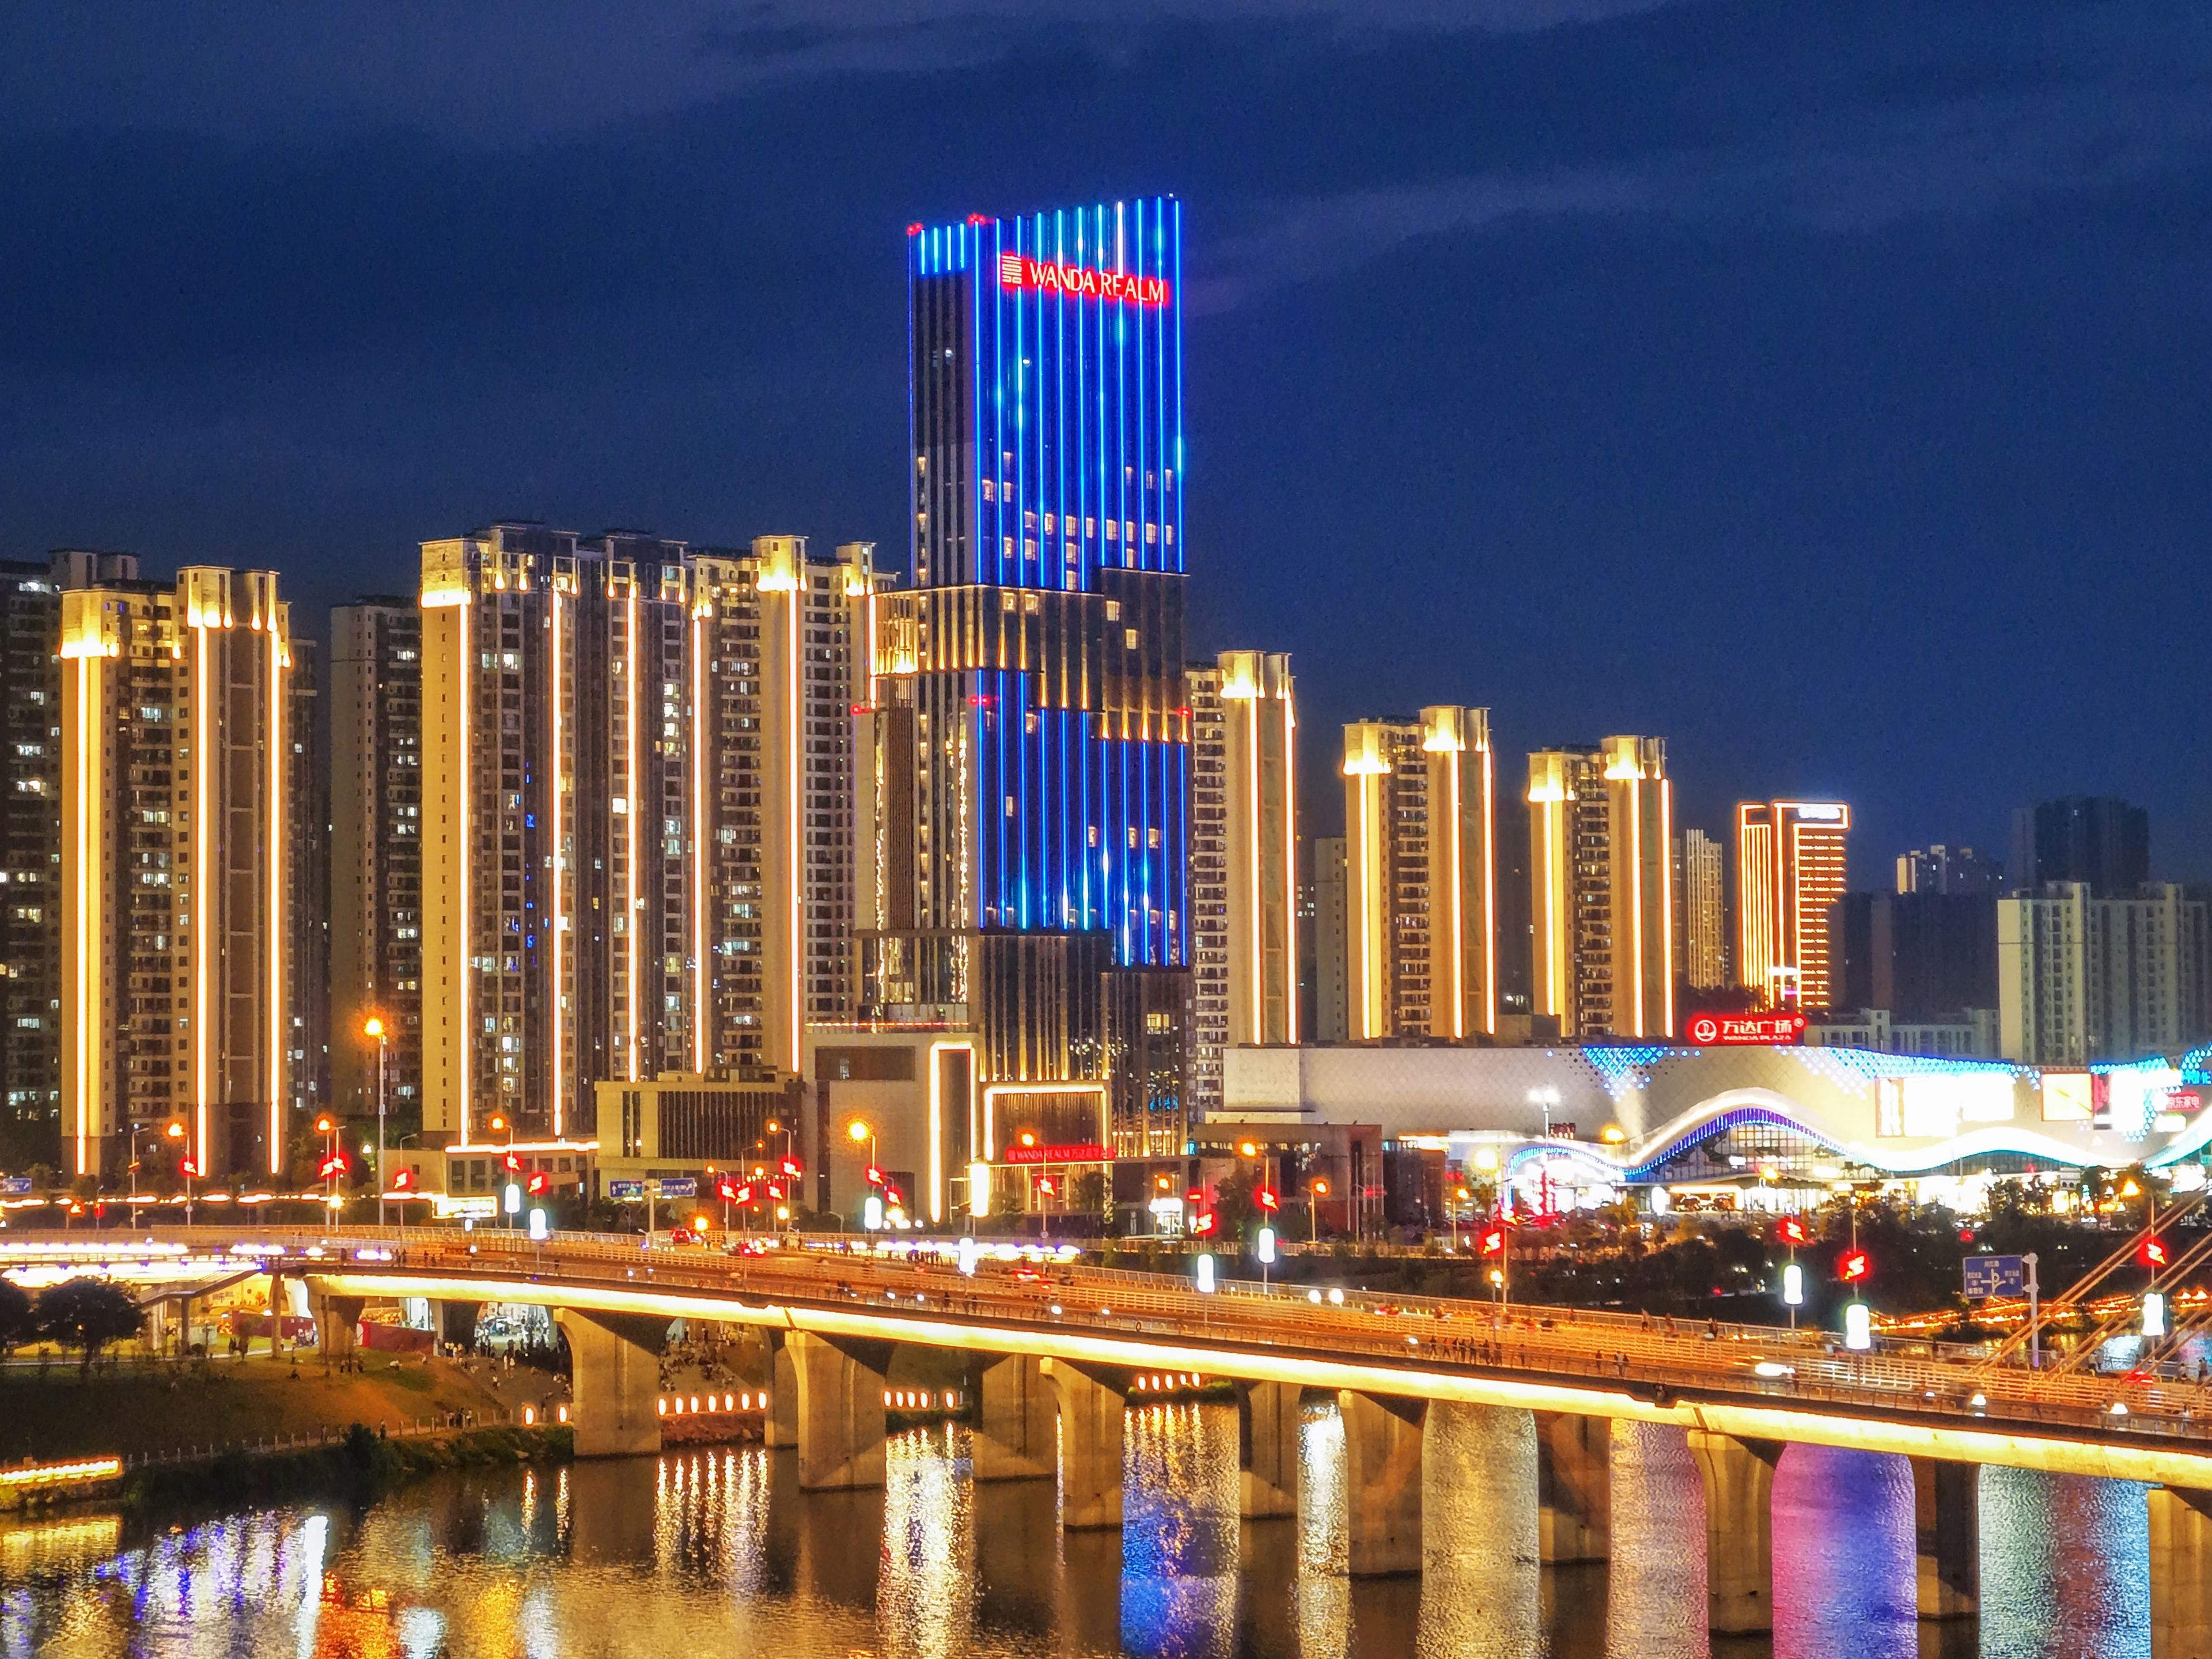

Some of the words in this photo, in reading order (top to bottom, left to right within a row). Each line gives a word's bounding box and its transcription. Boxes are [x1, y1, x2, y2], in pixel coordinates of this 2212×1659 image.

[1029, 262, 1096, 294] WANDA
[1100, 272, 1164, 302] REALM
[1722, 1020, 1792, 1034] 万达广场
[1016, 1149, 1043, 1160] WANDA
